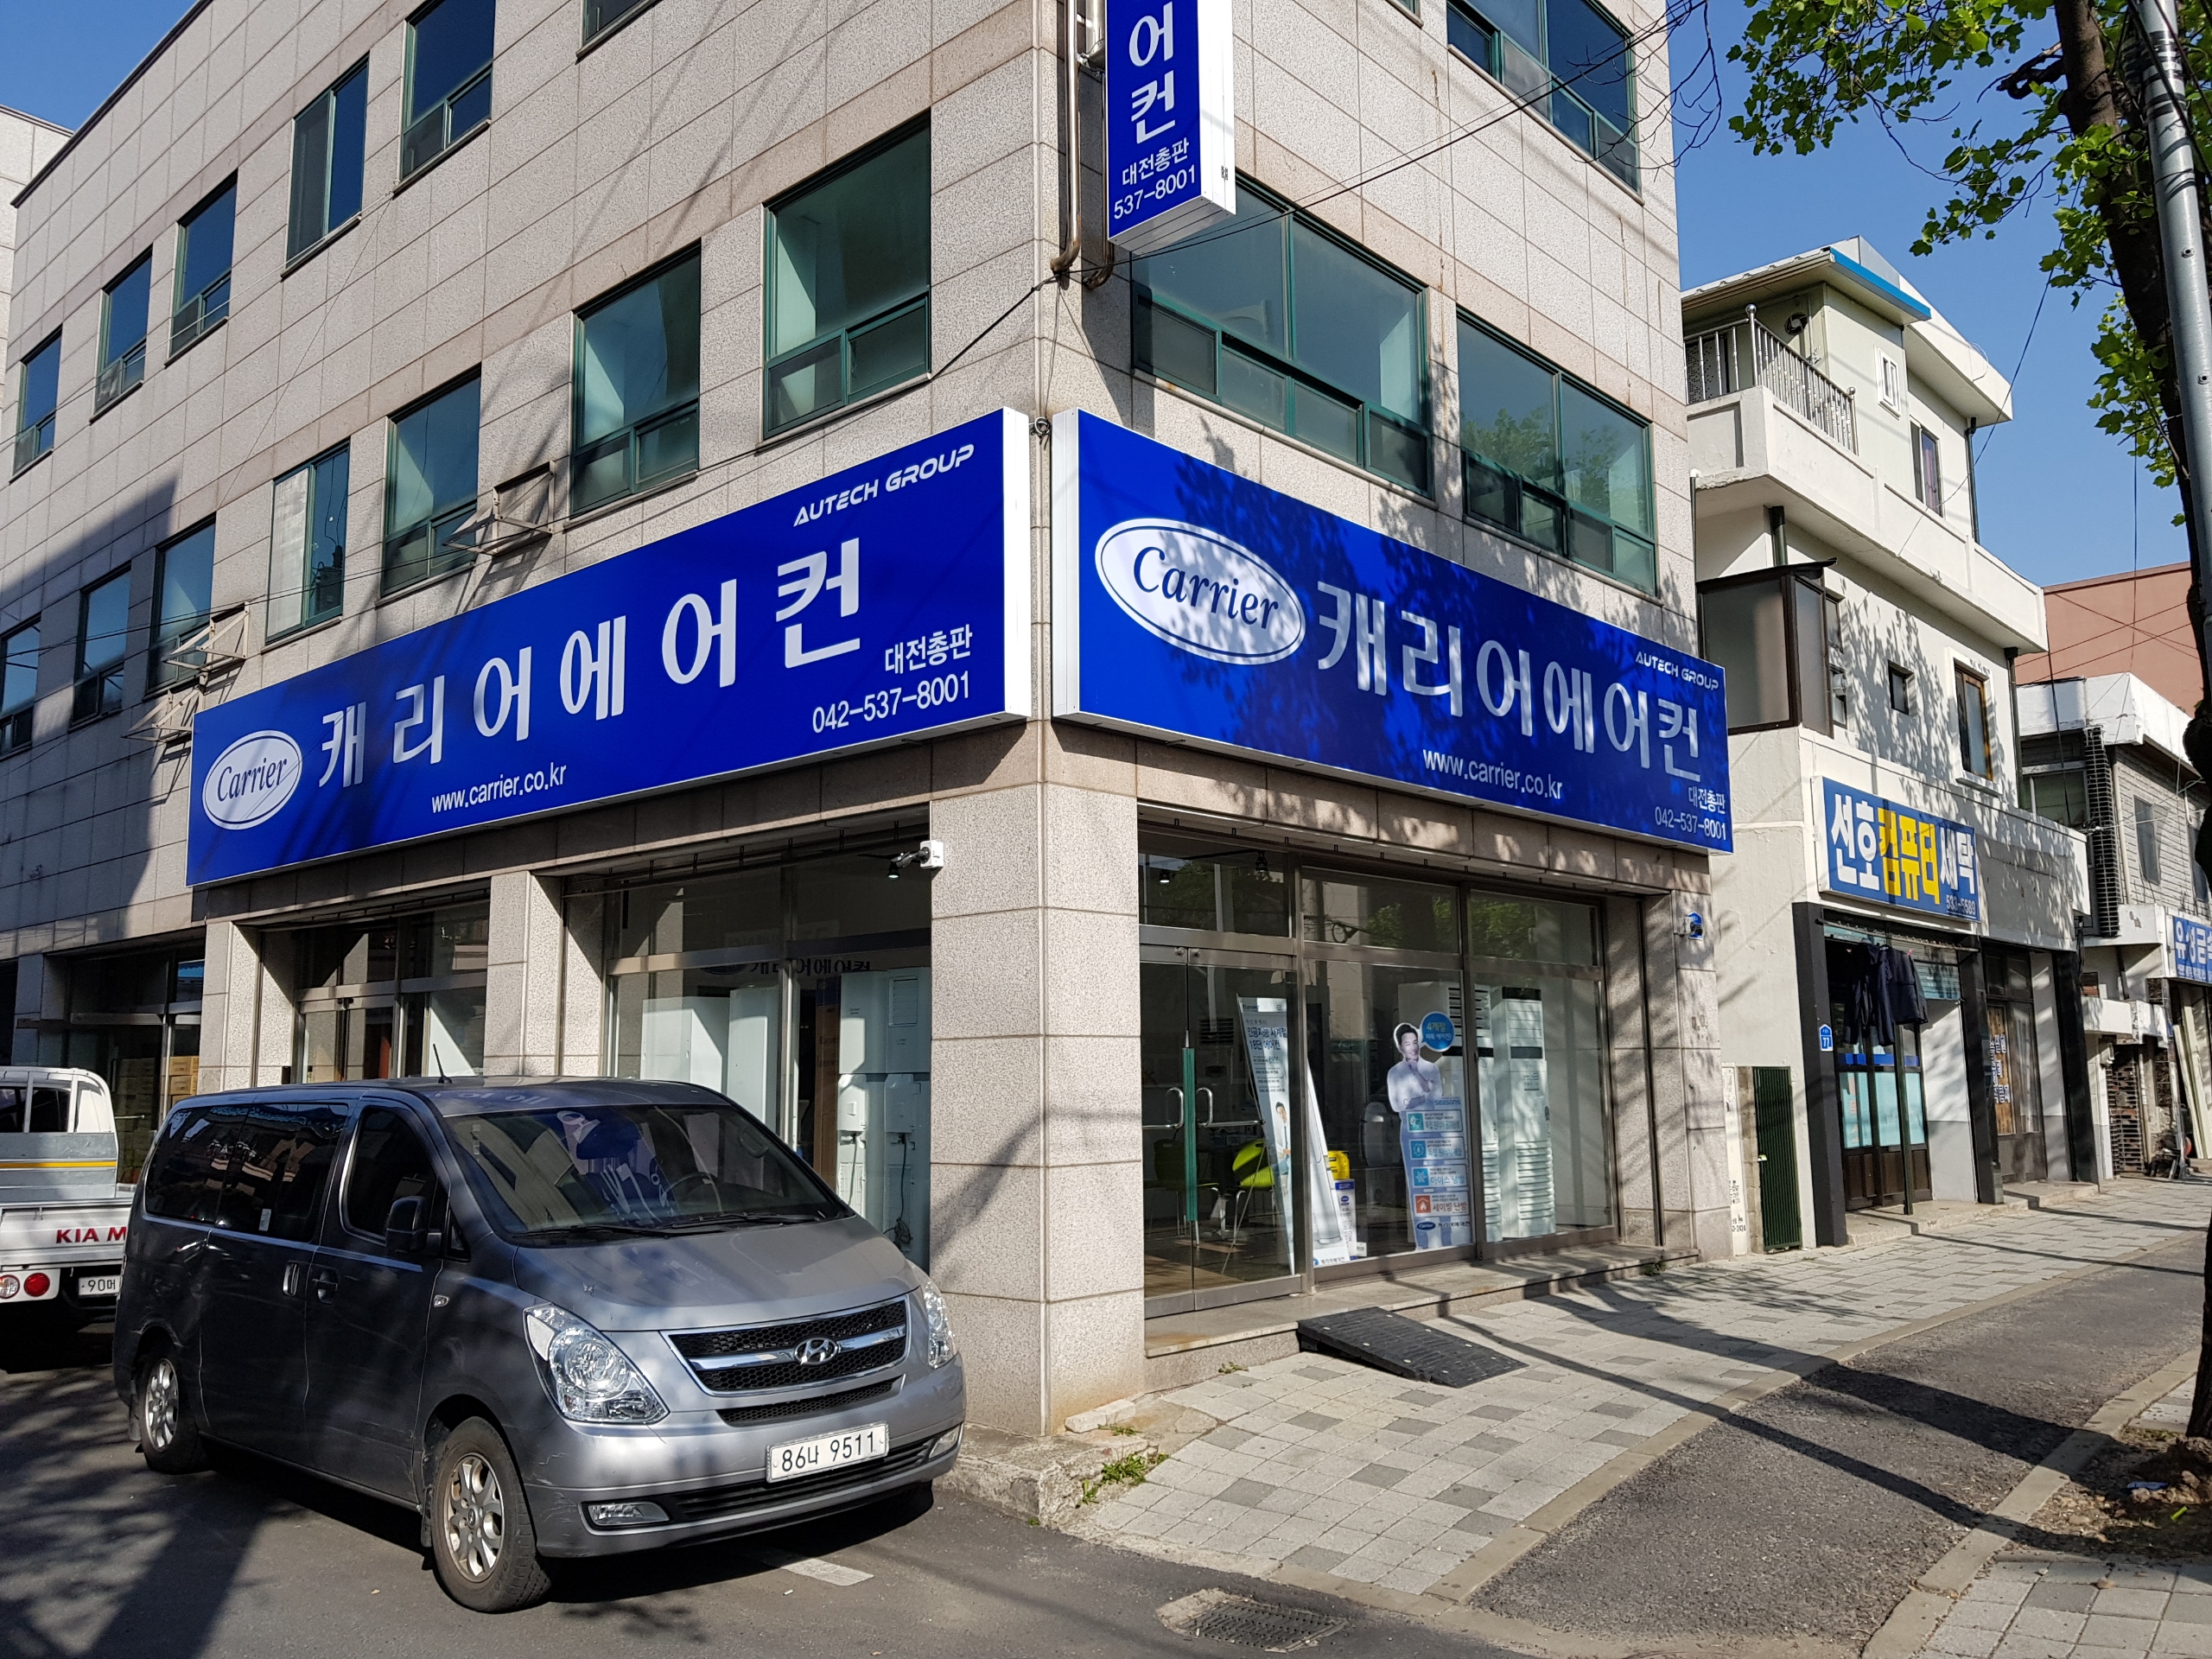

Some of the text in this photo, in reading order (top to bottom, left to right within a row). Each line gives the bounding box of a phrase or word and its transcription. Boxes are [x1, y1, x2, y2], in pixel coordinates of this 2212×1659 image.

[1122, 137, 1189, 185] 대전총판
[1114, 164, 1195, 219] 537-8001
[793, 443, 975, 527] AUTECH GROUP
[1133, 546, 1279, 630] Carrier
[885, 624, 973, 674] 대전총판
[1635, 651, 1719, 691] AUTECH GROUP
[812, 671, 969, 734] 042-537-8001
[1317, 580, 1701, 783] 캐리어에어컨
[217, 757, 288, 803] Carrier
[431, 761, 567, 814] www.carrier.co.kr
[1422, 748, 1563, 799] www.carrier.co.kr
[1655, 805, 1726, 841] 042-537-8001
[1688, 786, 1726, 814] 대전총판
[56, 1228, 99, 1244] KIA
[781, 1431, 874, 1471] 86나 9511
